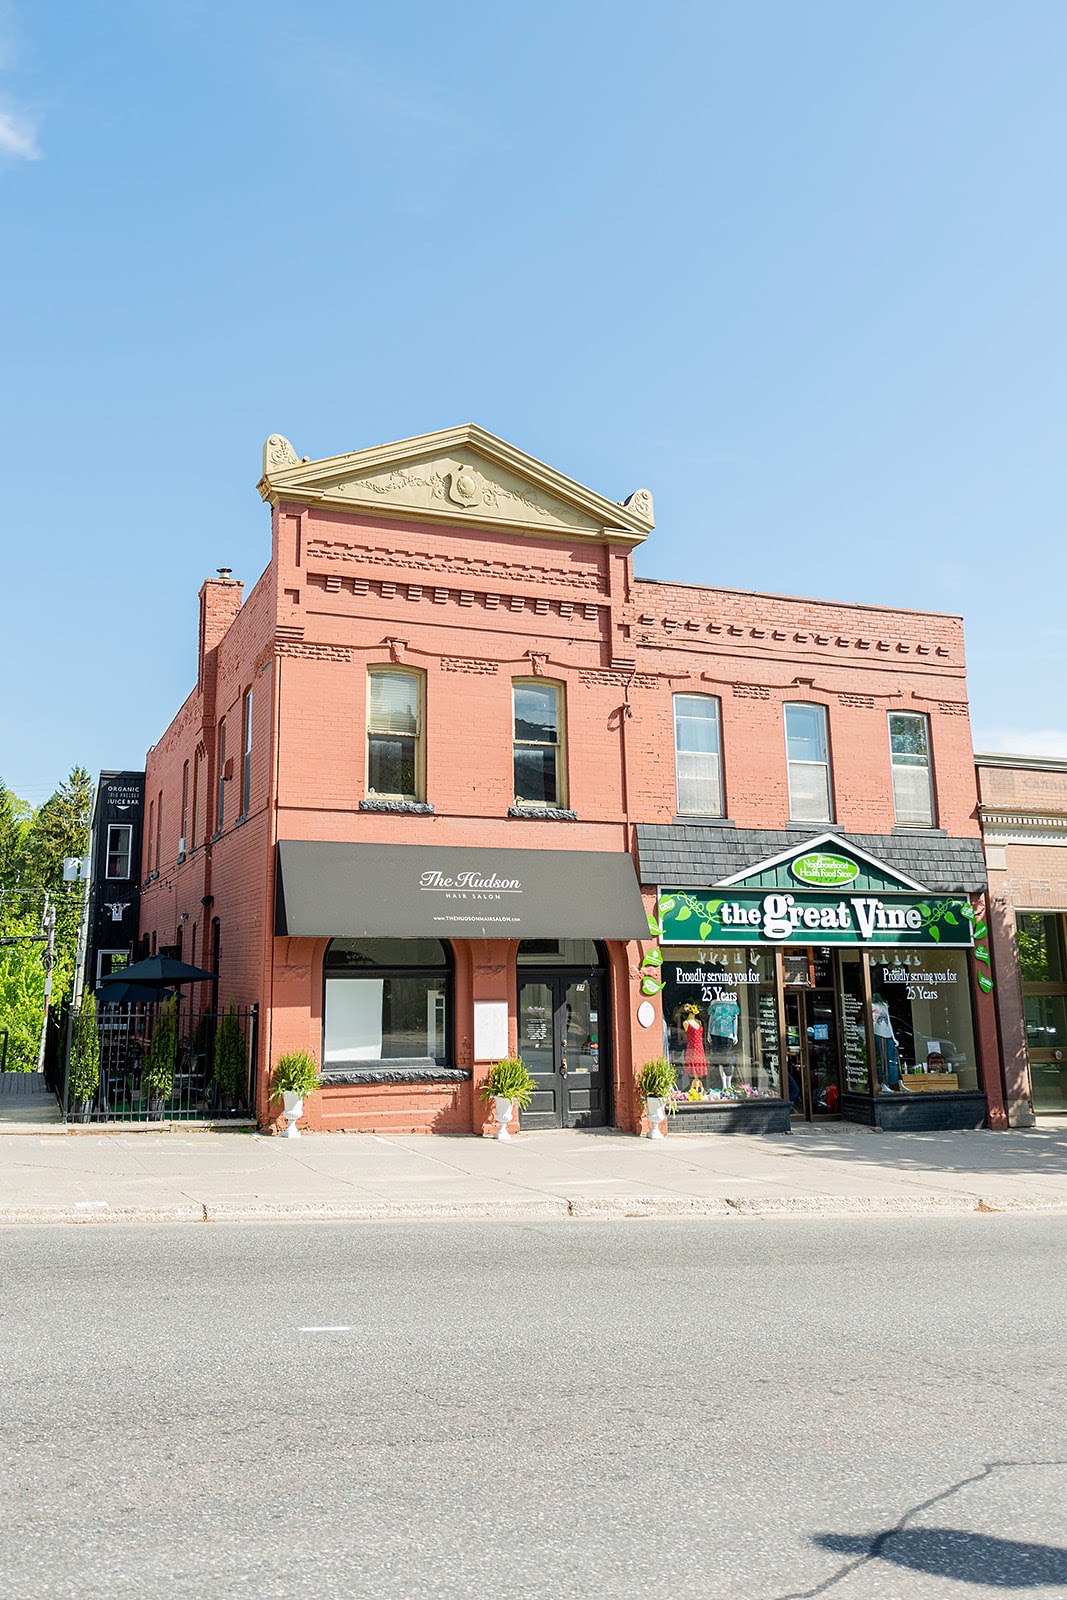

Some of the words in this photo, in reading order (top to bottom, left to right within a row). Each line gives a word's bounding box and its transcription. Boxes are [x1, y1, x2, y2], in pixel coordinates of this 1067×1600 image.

[799, 867, 820, 877] Health
[820, 868, 836, 877] Food
[836, 869, 853, 878] Store
[803, 859, 849, 869] Neighbourhood
[419, 870, 454, 887] The
[454, 871, 522, 889] Hudson
[720, 902, 762, 925] the
[763, 894, 850, 939] great
[850, 898, 922, 939] Vine
[676, 967, 707, 986] Proudly
[707, 968, 734, 986] serving
[734, 972, 748, 986] you
[748, 968, 760, 982] for
[882, 967, 910, 986] Proudly
[910, 968, 934, 985] serving
[934, 972, 946, 986] you
[946, 968, 957, 981] for
[701, 986, 713, 1002] 25
[713, 986, 738, 1002] Years
[906, 985, 916, 1000] 25
[916, 985, 938, 1000] Years
